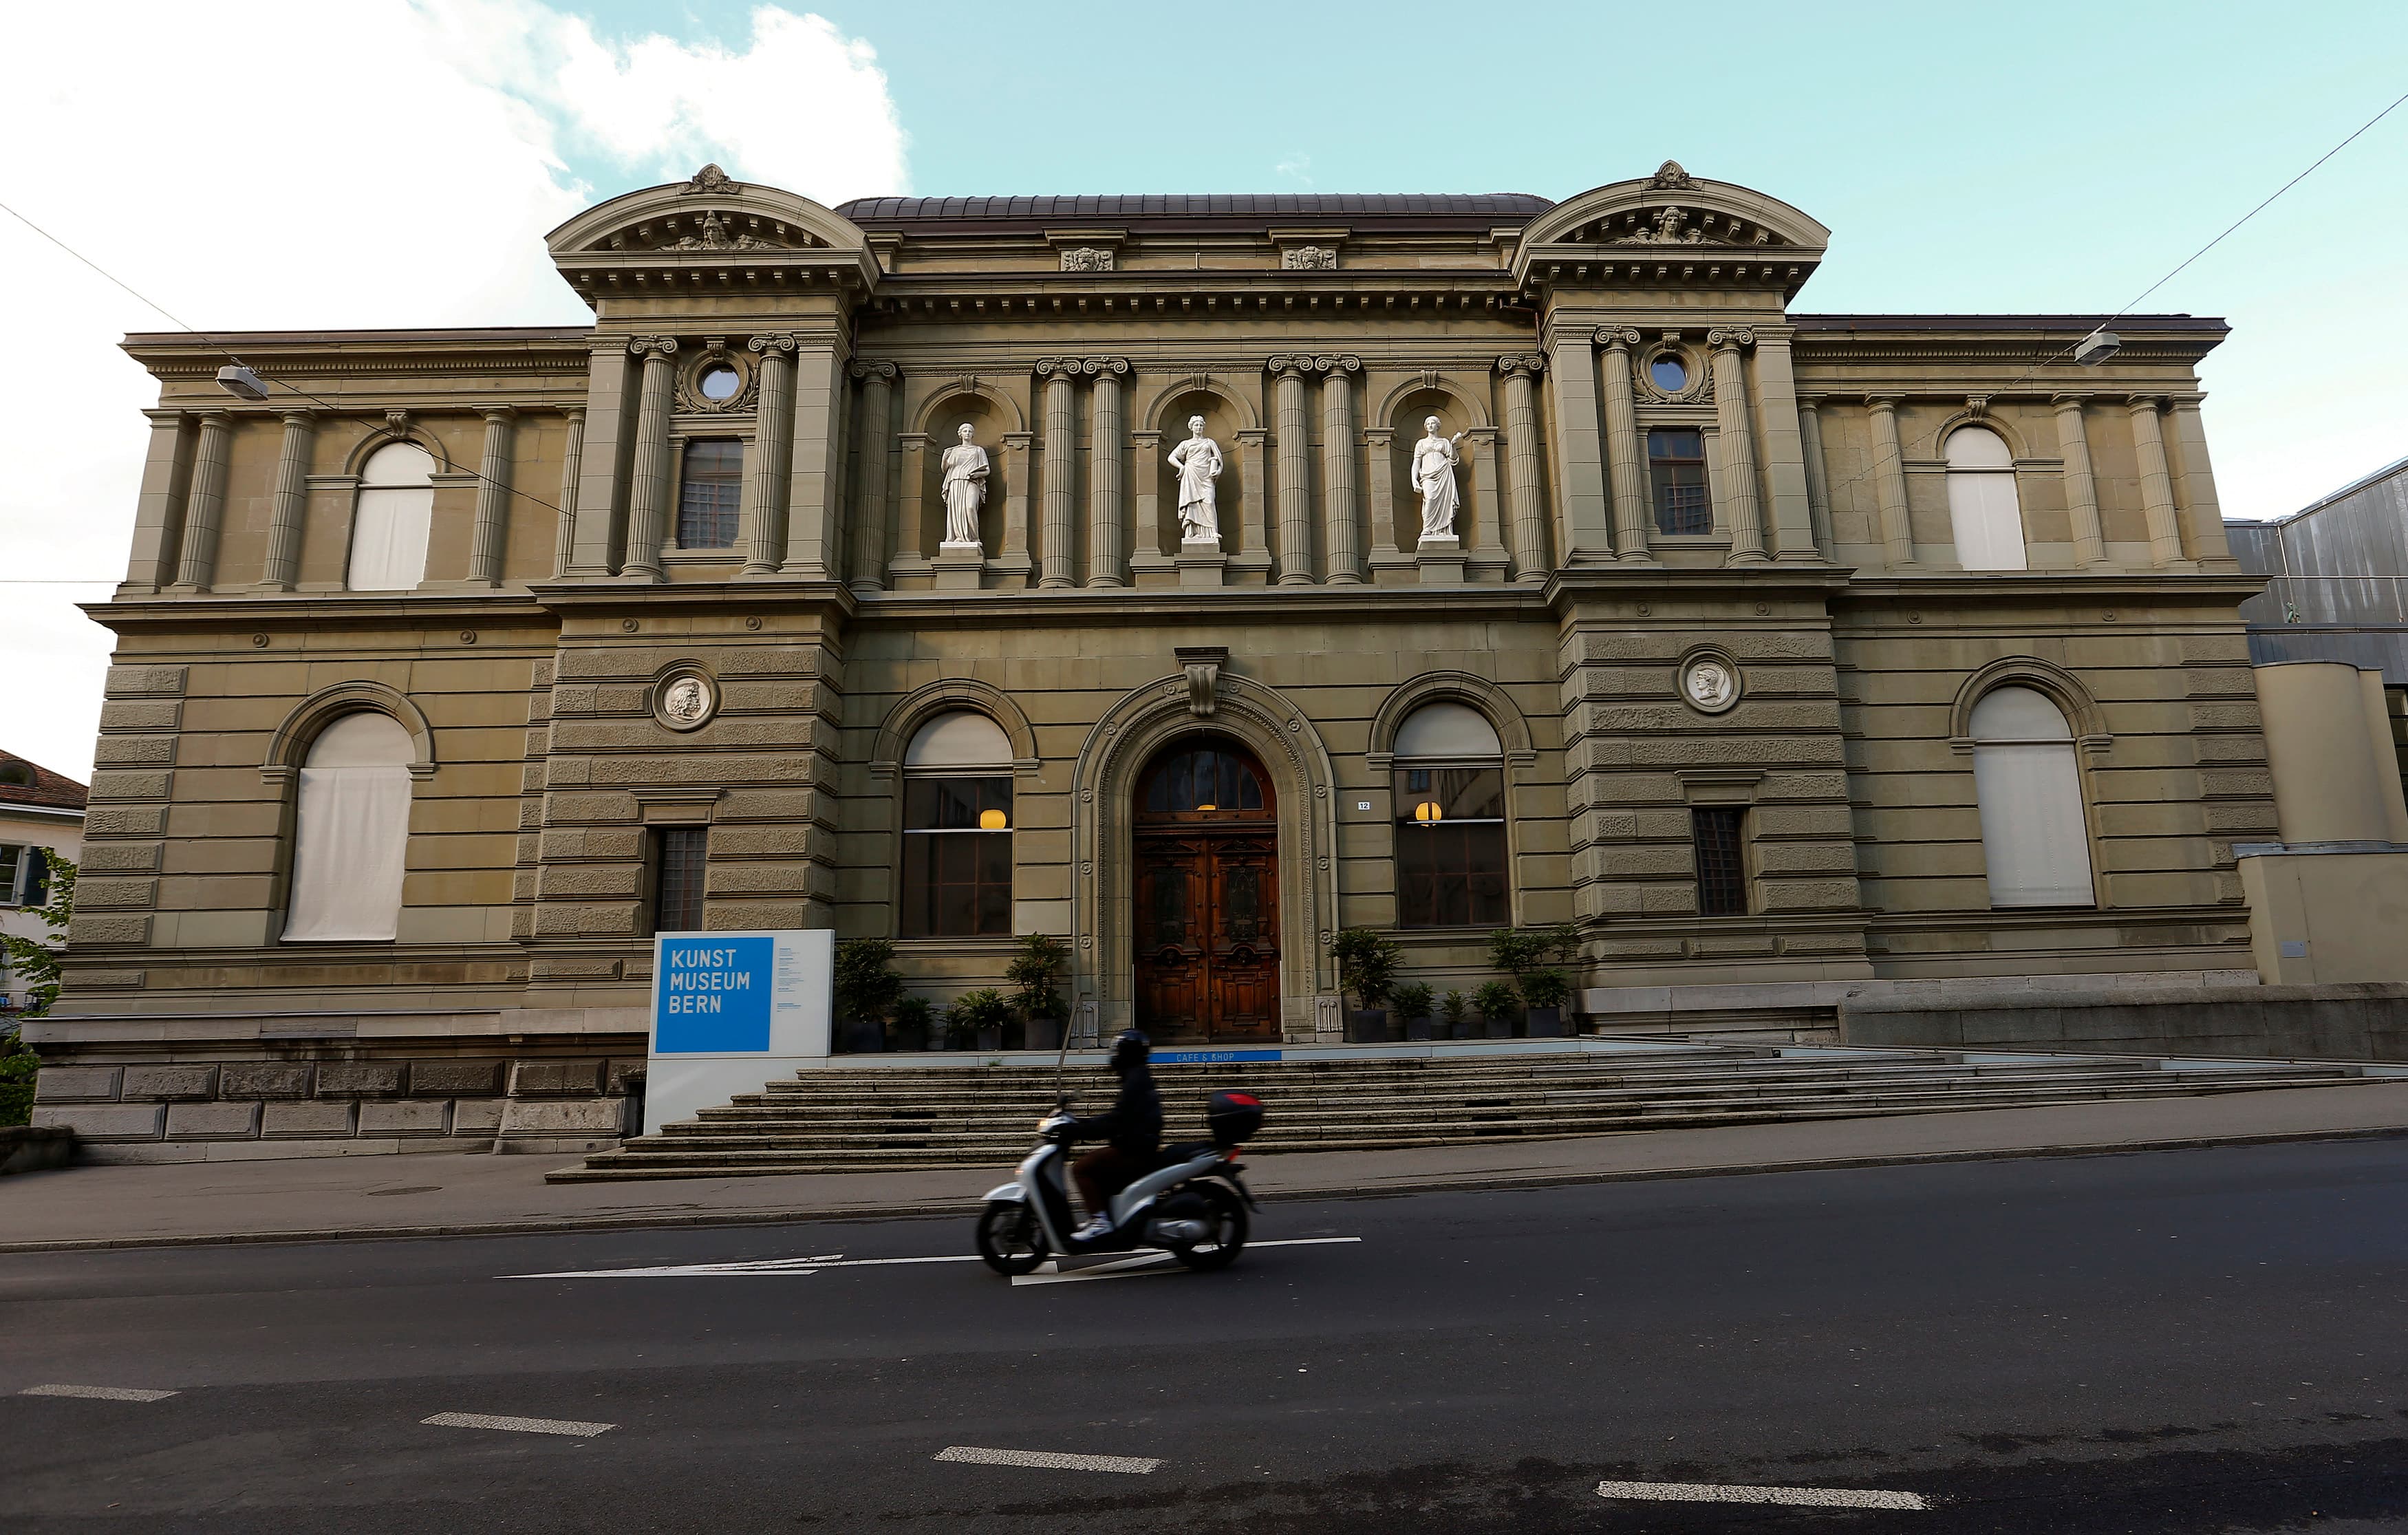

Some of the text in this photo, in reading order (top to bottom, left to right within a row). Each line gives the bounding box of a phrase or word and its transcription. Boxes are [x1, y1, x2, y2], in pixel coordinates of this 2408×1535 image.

[671, 949, 737, 968] KUNST
[670, 972, 750, 991] MUSEUM
[669, 995, 722, 1013] BERN
[1212, 1053, 1234, 1062] SHOP
